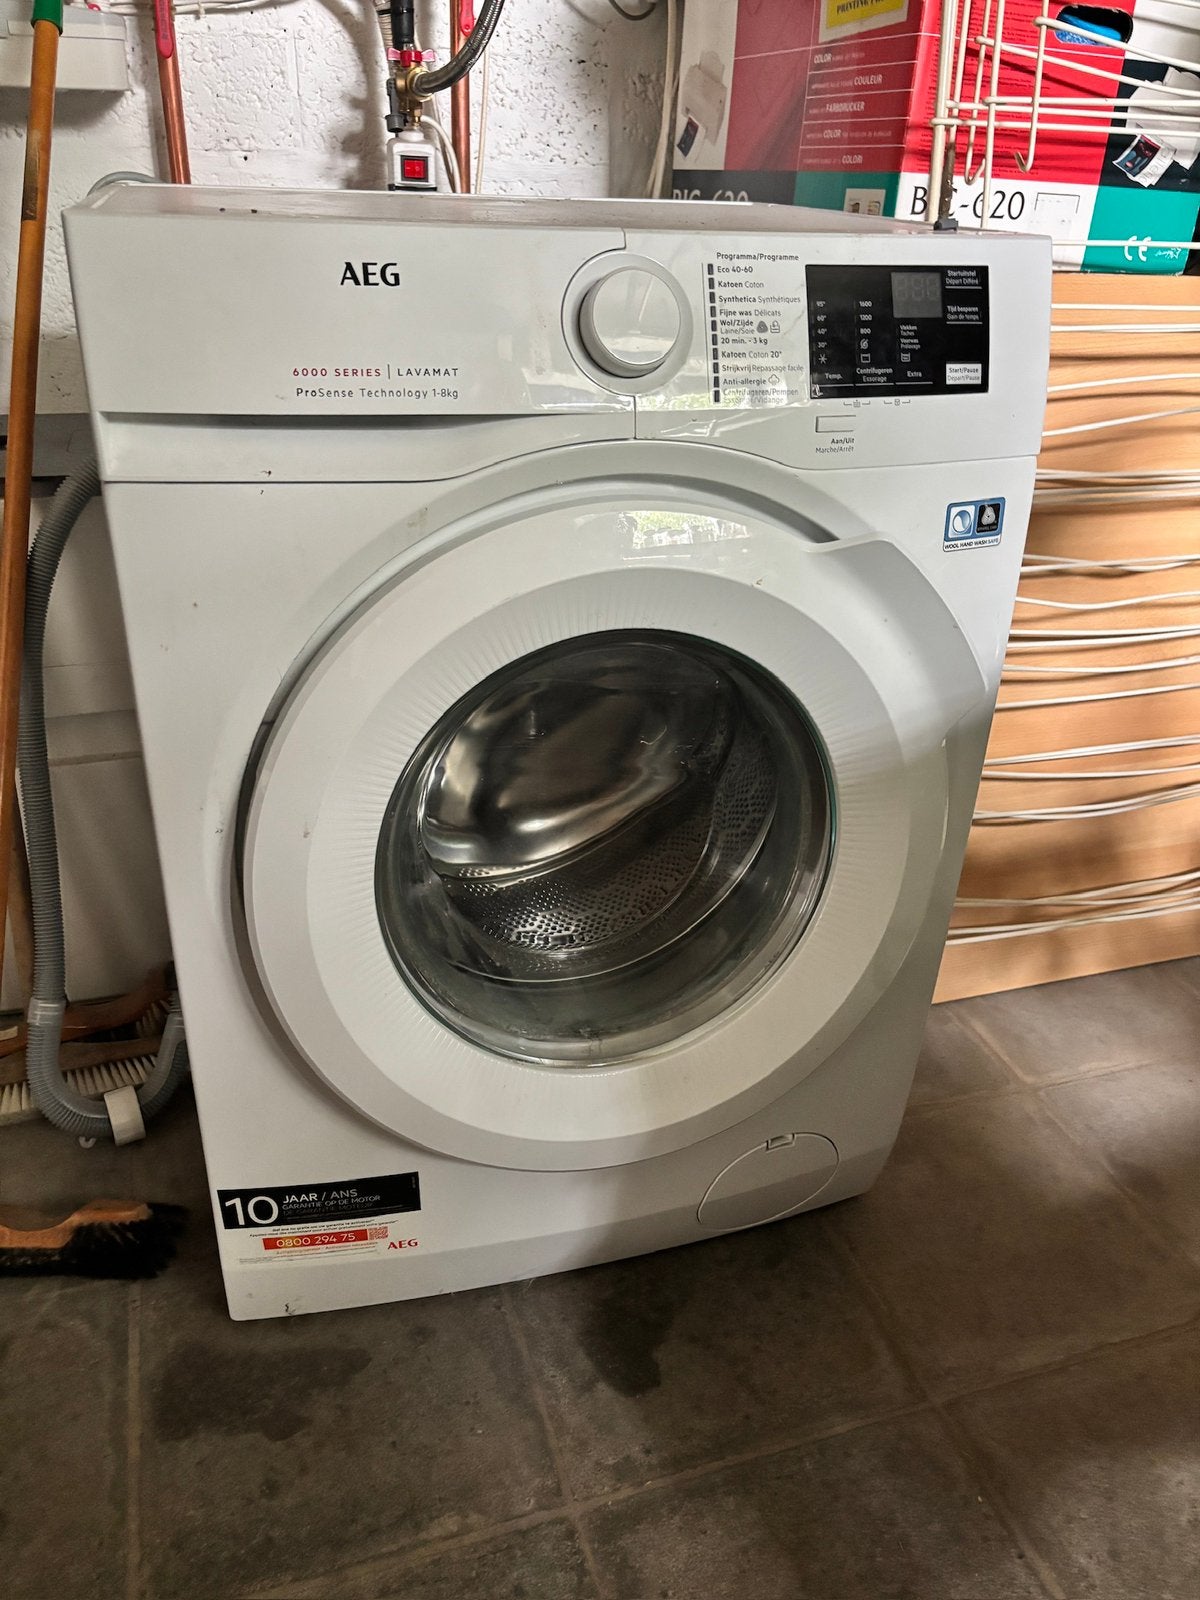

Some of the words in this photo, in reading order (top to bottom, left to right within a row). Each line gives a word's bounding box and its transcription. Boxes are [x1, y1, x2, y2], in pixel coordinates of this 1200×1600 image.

[854, 74, 883, 86] COULEUR
[910, 186, 1025, 220] B-620
[716, 252, 800, 262] Programma/Programme
[717, 265, 730, 273] Eco
[731, 265, 753, 273] 40-60
[340, 261, 401, 287] AEG
[718, 280, 743, 288] Katoen
[744, 280, 765, 288] Coton
[718, 295, 757, 304] Synthetica
[757, 295, 801, 304] Synthétiques
[719, 308, 737, 317] Fijne
[754, 308, 782, 316] Délicats
[720, 319, 754, 327] Wol/Zijde
[720, 327, 755, 335] Laine/Soie
[759, 337, 768, 345] kg
[721, 350, 747, 358] Katoen
[748, 350, 769, 358] Coton
[292, 367, 328, 377] 6000
[334, 367, 382, 377] SERIES
[397, 367, 459, 377] LAVAMAT
[722, 364, 752, 373] Strijkvrij
[752, 364, 786, 373] Repassage
[787, 363, 804, 372] facile
[856, 367, 893, 375] Centrifugeren
[722, 378, 767, 386] Anti-allergie
[862, 375, 887, 383] Essorage
[296, 387, 354, 398] ProSense
[359, 387, 428, 400] Technology
[432, 387, 459, 400] 1-8kg
[830, 437, 855, 445] Aan/Uit
[283, 1192, 318, 1204] JAAR
[321, 1191, 327, 1201] /
[330, 1188, 358, 1199] ANS
[281, 1200, 321, 1211] GARANTIE
[324, 1199, 337, 1207] OP
[338, 1198, 350, 1206] DE
[351, 1194, 381, 1204] MOTOR
[224, 1195, 279, 1226] 10
[276, 1237, 311, 1248] 0800
[315, 1235, 337, 1245] 294
[341, 1232, 356, 1242] 75
[387, 1238, 418, 1250] AEG
